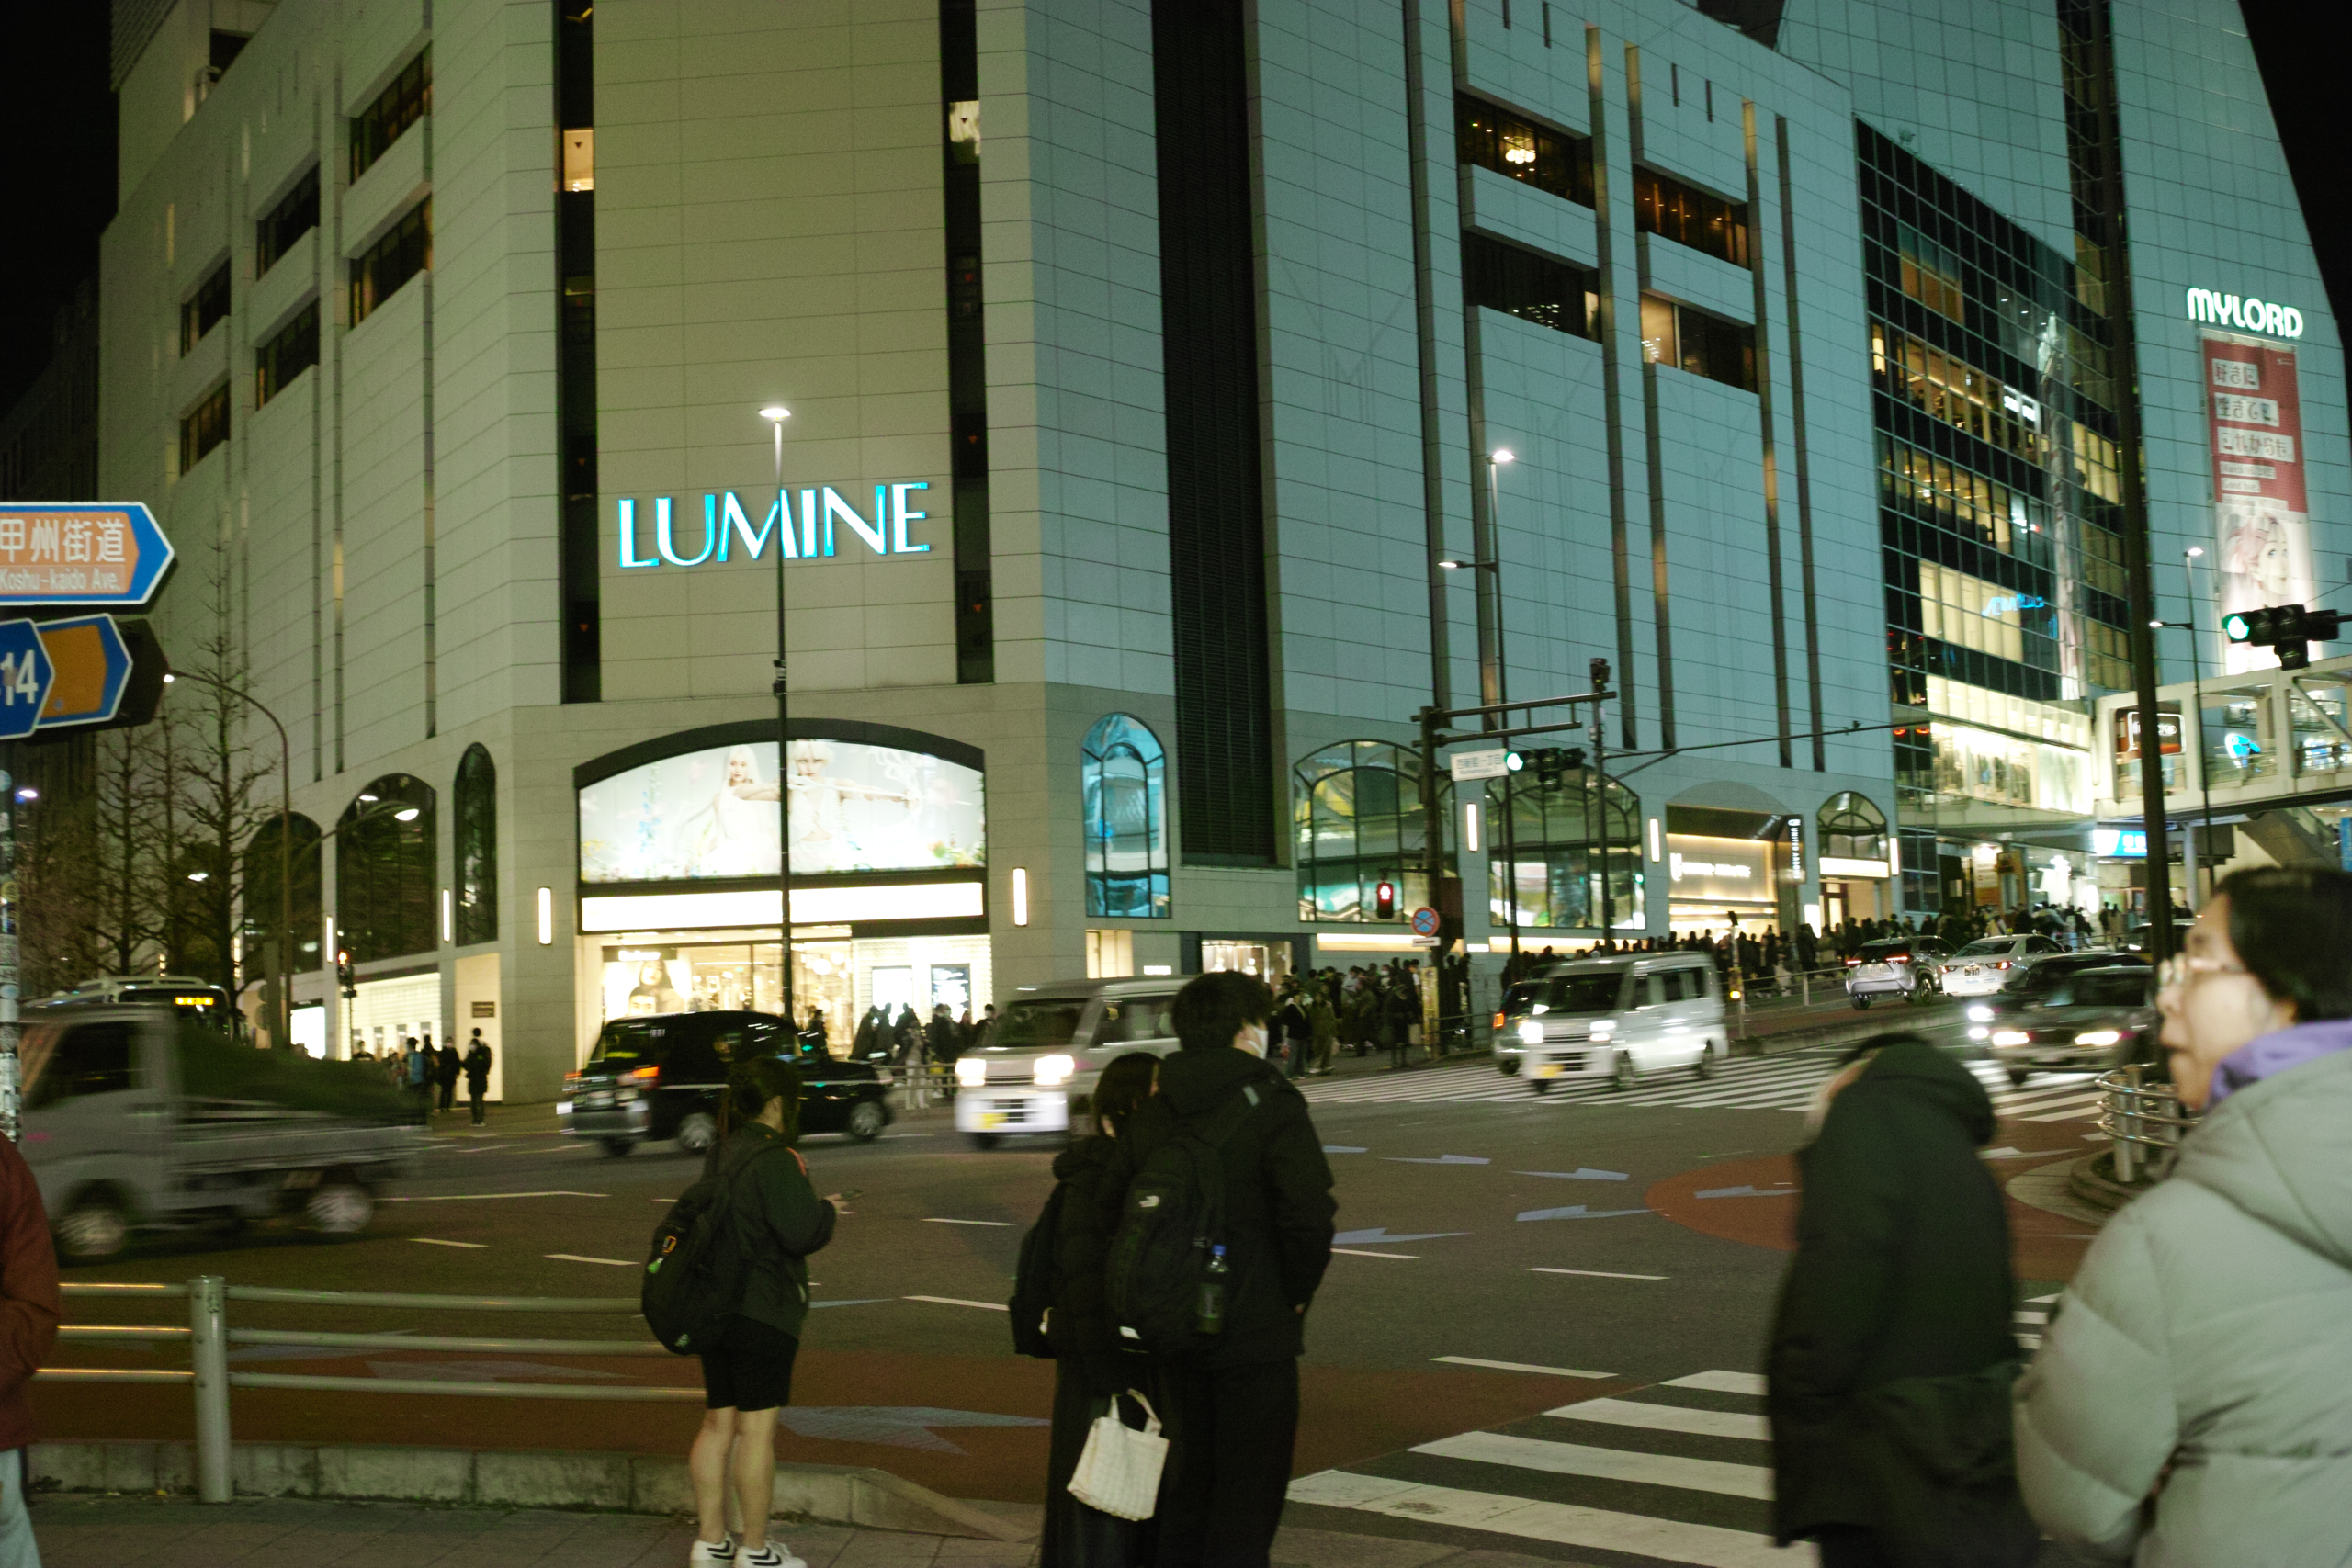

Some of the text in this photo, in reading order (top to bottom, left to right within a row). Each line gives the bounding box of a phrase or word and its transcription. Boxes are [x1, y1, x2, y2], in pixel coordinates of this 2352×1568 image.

[2187, 287, 2303, 338] MYLORD
[2215, 362, 2256, 386] 好きに
[0, 518, 126, 563] 甲州街道
[618, 482, 930, 568] LUMINE
[92, 567, 121, 592] Ave.
